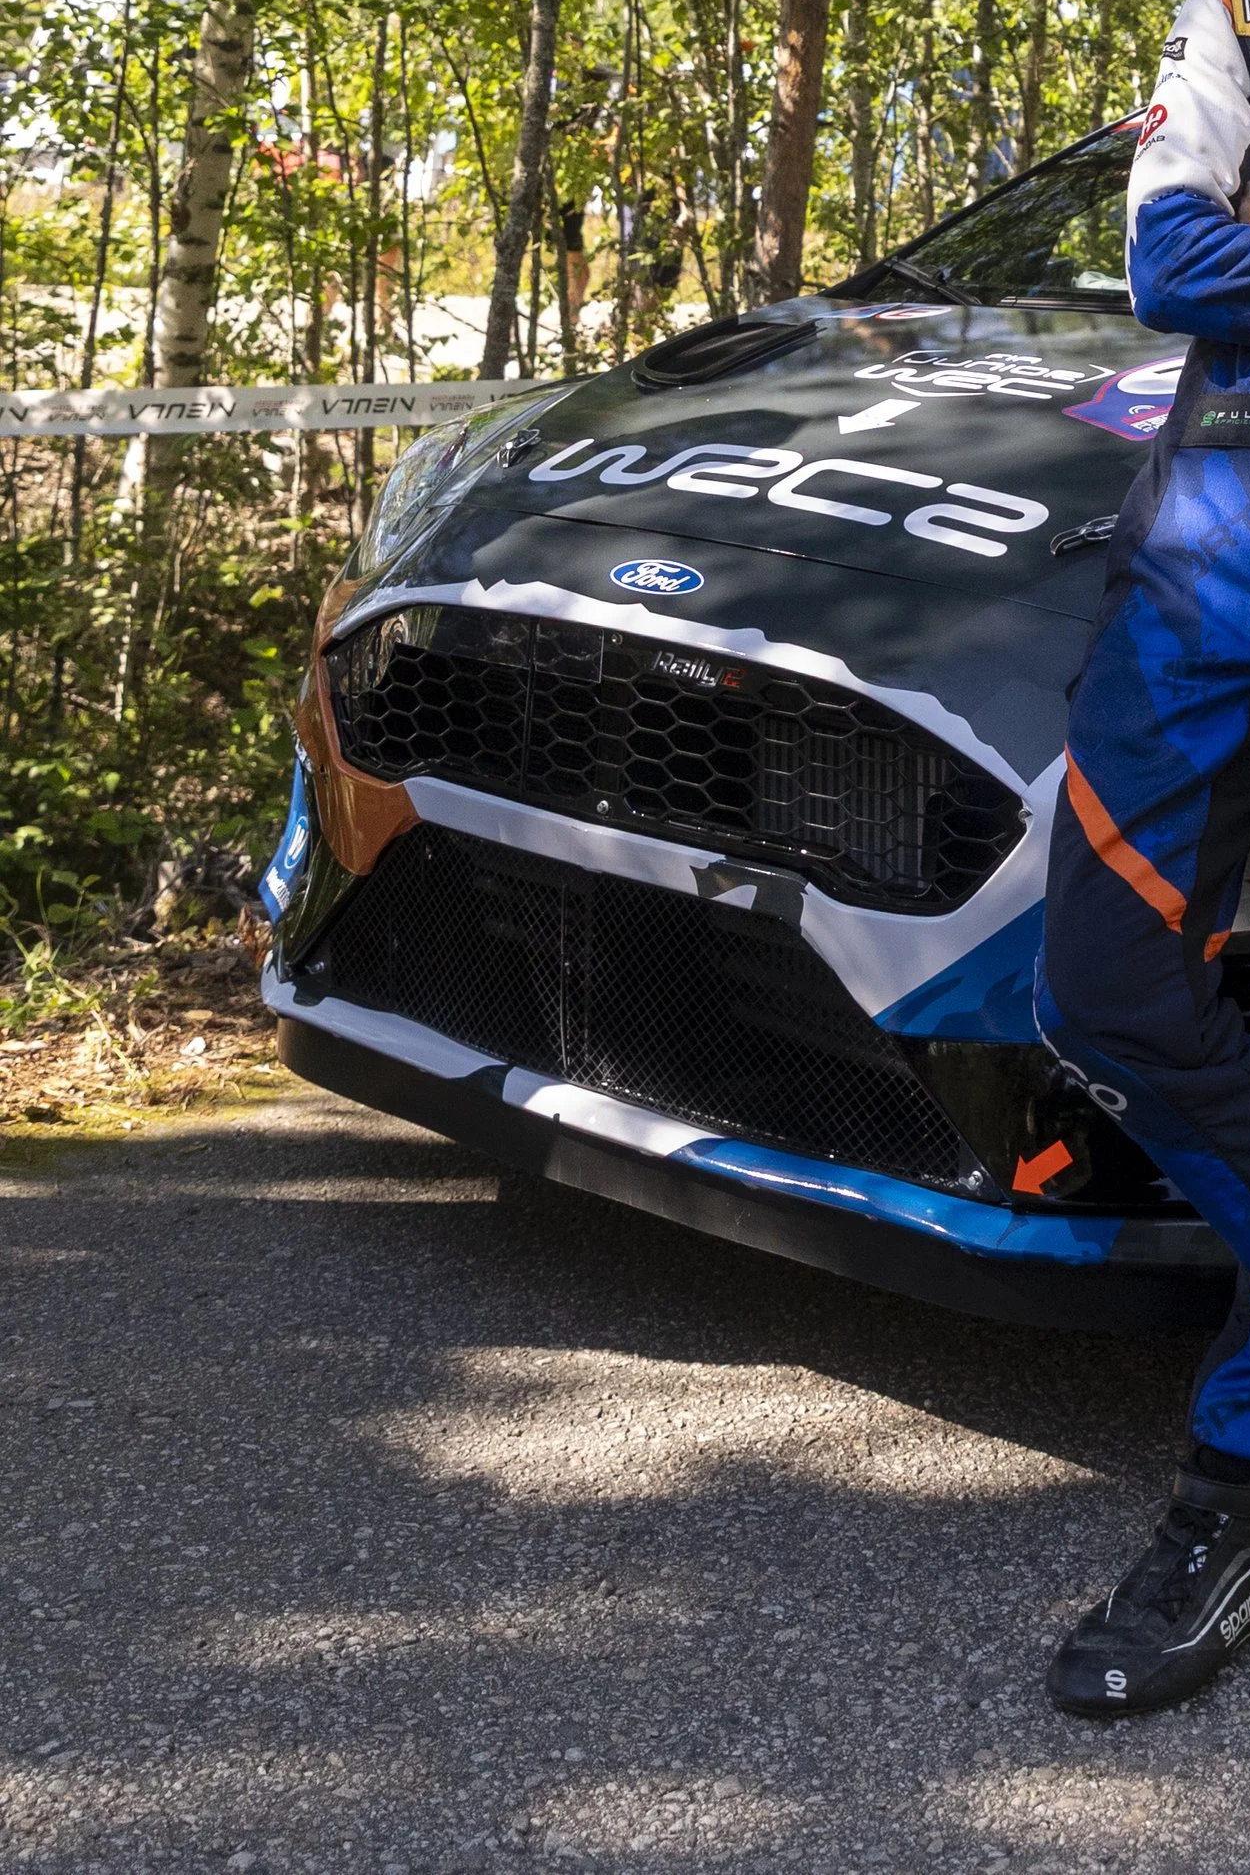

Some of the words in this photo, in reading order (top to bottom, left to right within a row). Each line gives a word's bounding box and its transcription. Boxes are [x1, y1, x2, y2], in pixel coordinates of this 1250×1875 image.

[853, 363, 1075, 400] WRC
[904, 356, 1086, 383] JUNIOR
[528, 438, 1049, 557] WRC2
[620, 562, 691, 592] Ford
